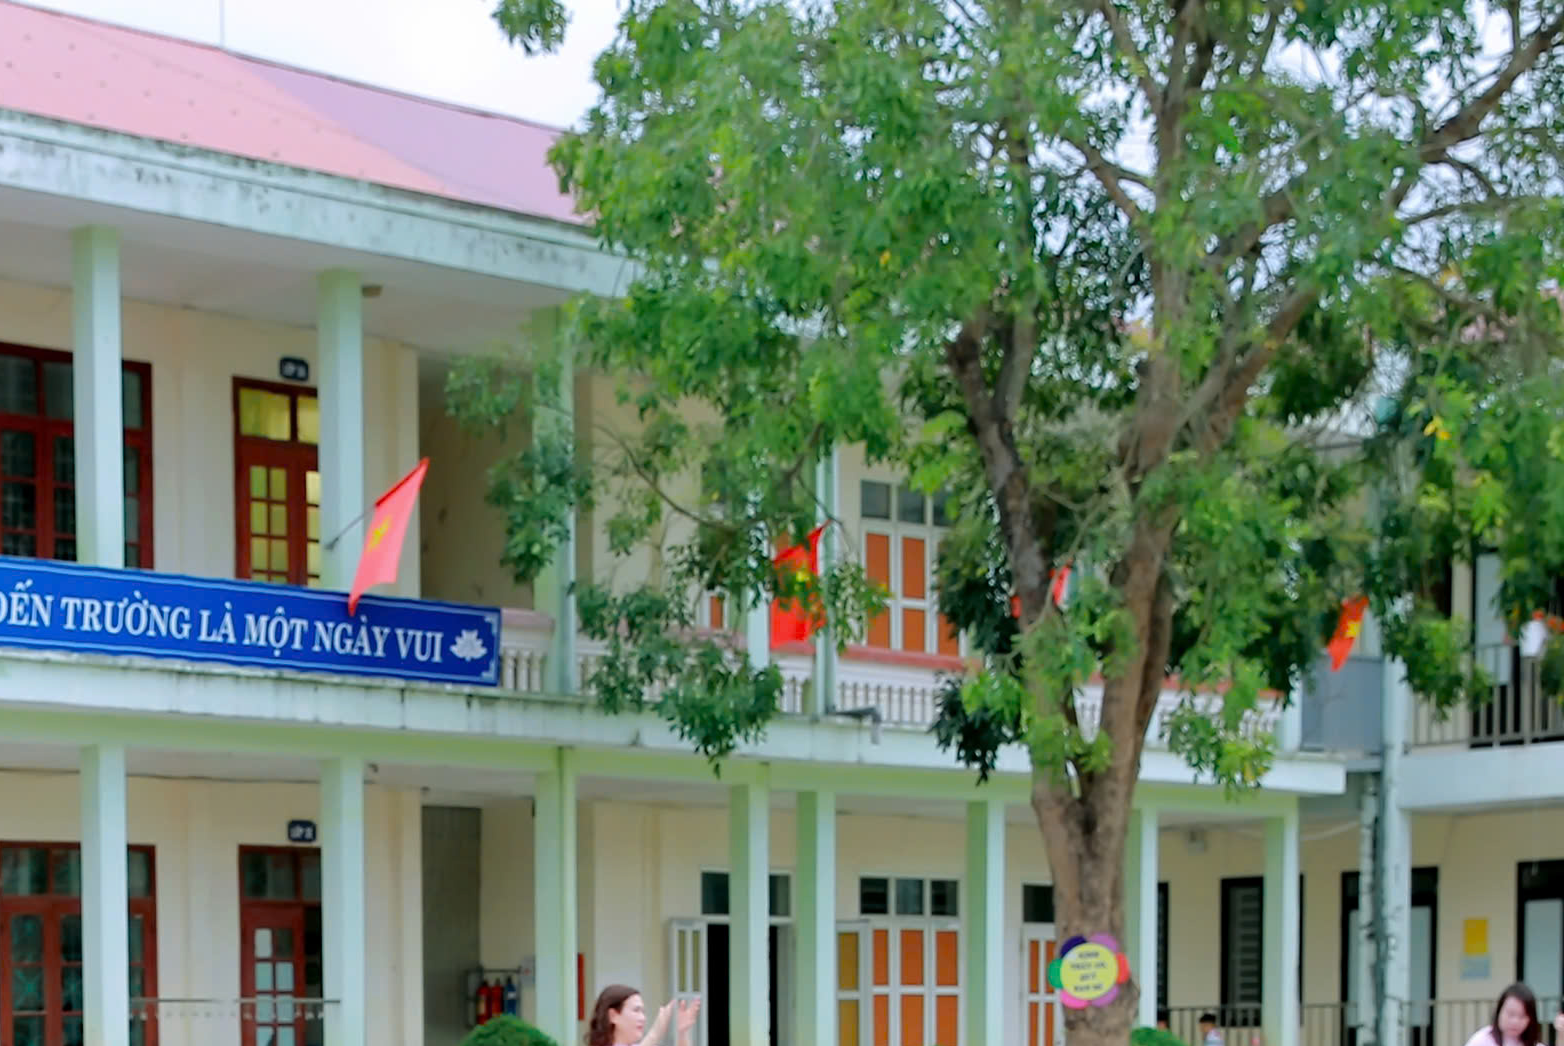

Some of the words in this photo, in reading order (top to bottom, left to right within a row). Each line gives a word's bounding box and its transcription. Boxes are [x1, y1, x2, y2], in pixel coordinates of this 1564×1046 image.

[61, 590, 191, 639] TRƯỜNG
[198, 601, 237, 645] LÀ
[243, 606, 308, 657] MỘT
[312, 615, 390, 657] NGÀY
[395, 628, 443, 663] VUI
